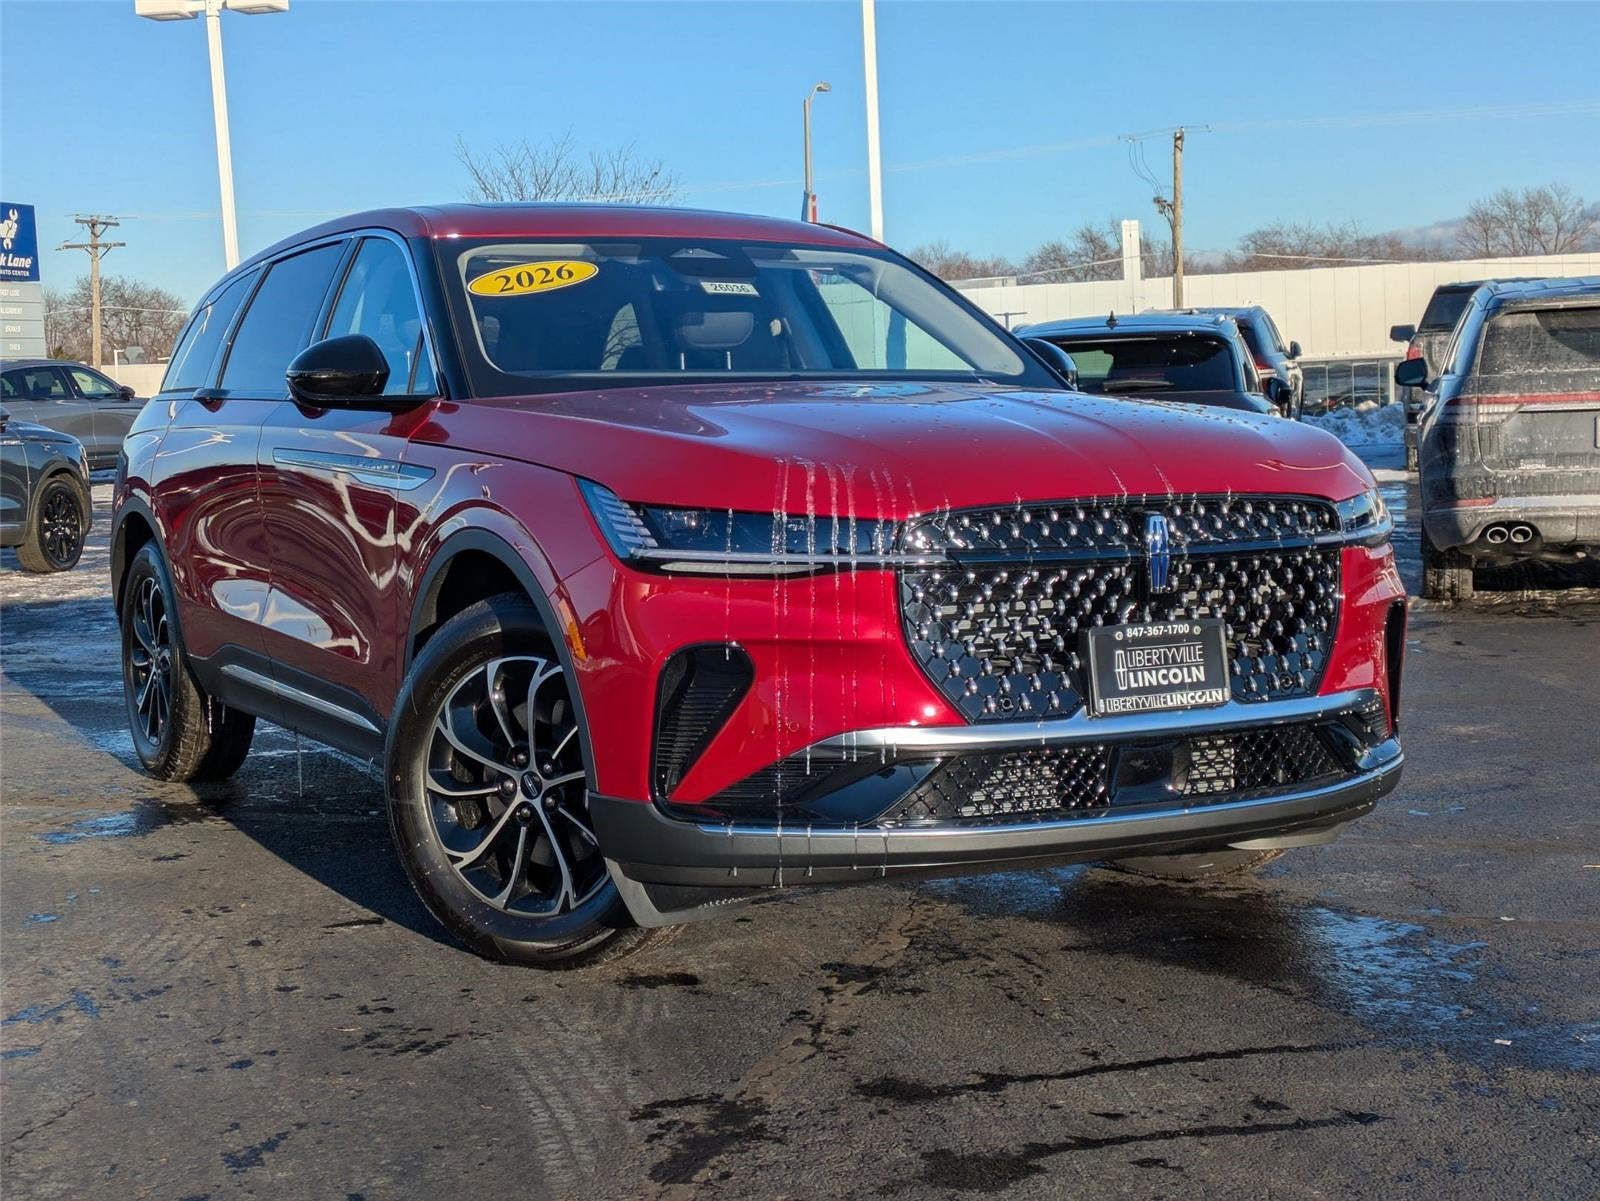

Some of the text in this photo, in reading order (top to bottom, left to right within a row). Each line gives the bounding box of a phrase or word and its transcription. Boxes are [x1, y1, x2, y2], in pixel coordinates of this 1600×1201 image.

[7, 253, 32, 268] Lane
[494, 263, 574, 293] 2026
[710, 283, 749, 293] 26036
[1126, 624, 1190, 638] 847-367-1700
[1127, 645, 1204, 668] LIBERTYVILLE
[1129, 666, 1206, 688] LINCOLN
